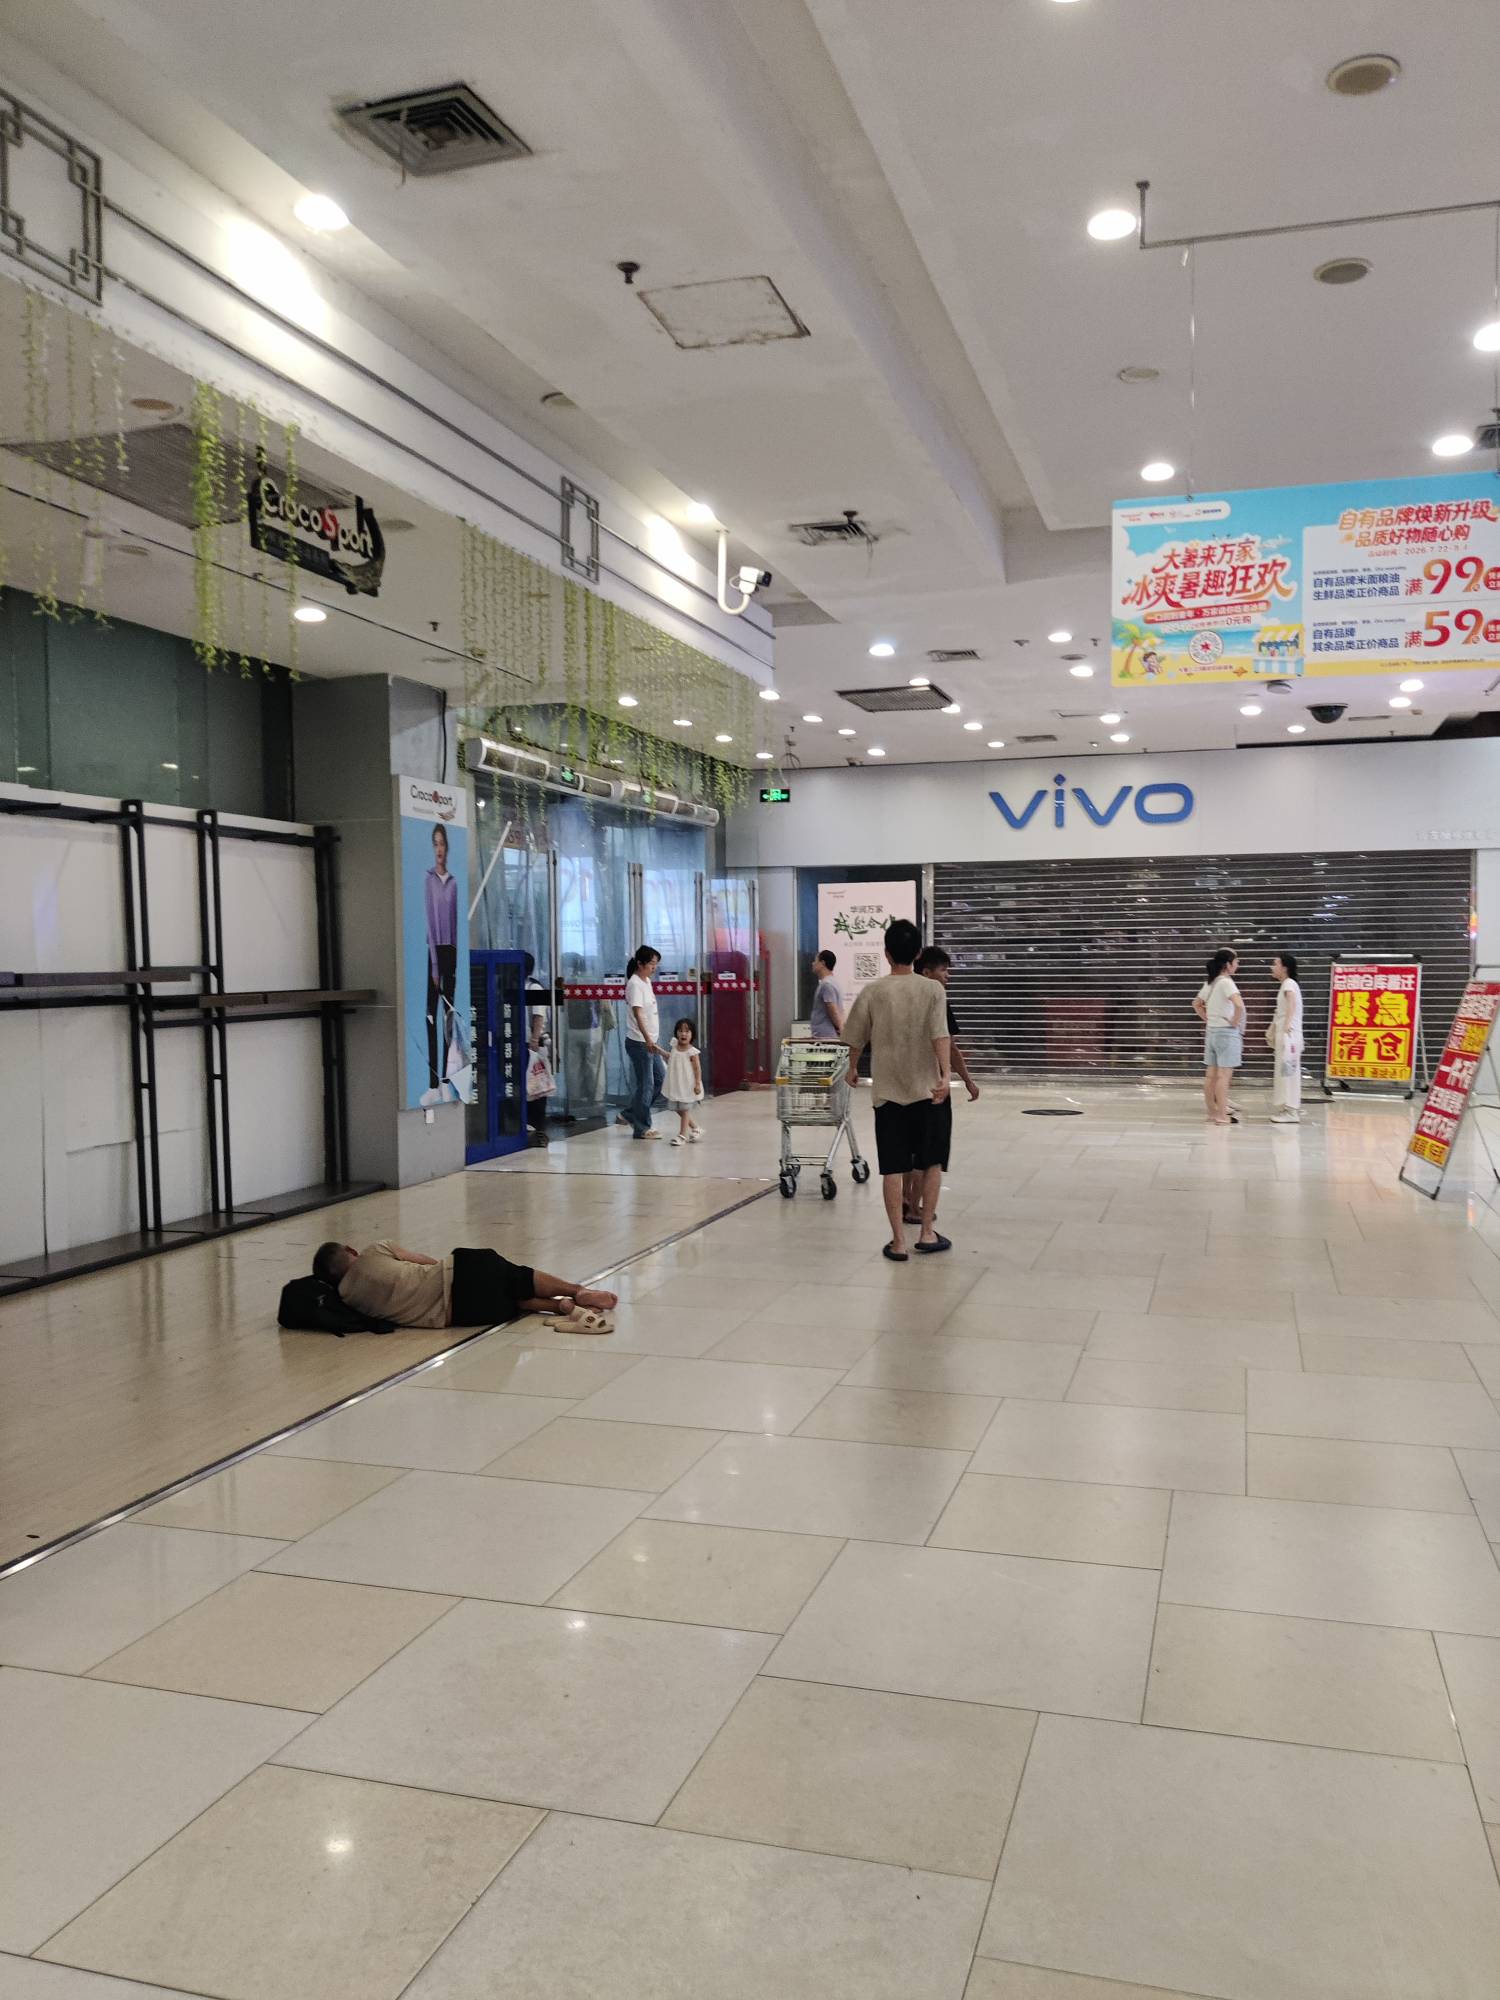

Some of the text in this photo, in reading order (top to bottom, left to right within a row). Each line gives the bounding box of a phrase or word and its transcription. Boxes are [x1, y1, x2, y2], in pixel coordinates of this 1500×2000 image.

[260, 477, 373, 558] CrocoSport
[1152, 539, 1256, 573] 大暑来万家
[1334, 991, 1411, 1026] 紧急
[1338, 1032, 1402, 1061] 清仓
